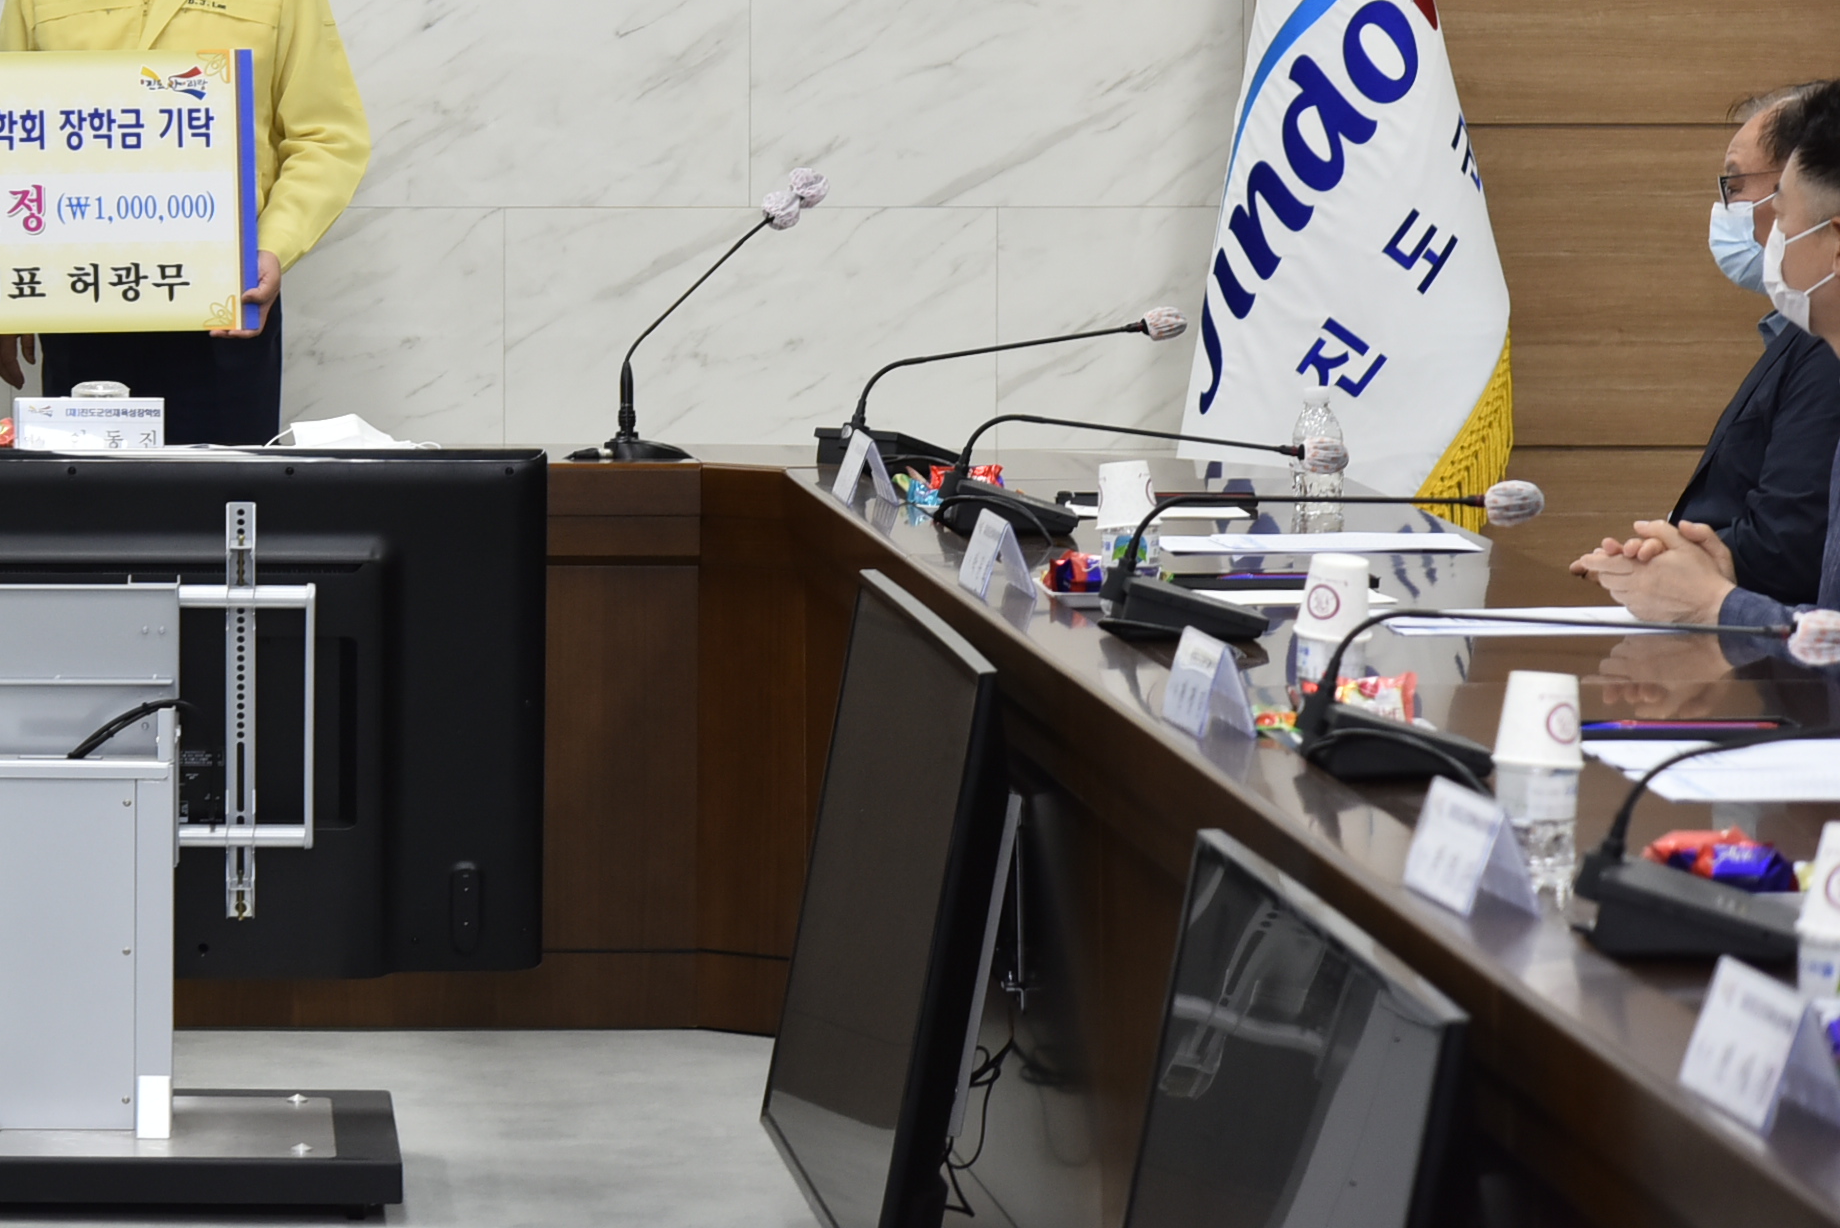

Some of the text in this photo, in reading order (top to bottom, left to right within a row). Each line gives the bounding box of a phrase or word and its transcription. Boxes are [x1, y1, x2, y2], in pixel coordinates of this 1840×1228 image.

[59, 108, 146, 151] 장학금
[158, 106, 216, 149] 기탁
[1200, 0, 1420, 415] Jindo
[67, 262, 191, 303] 허광무
